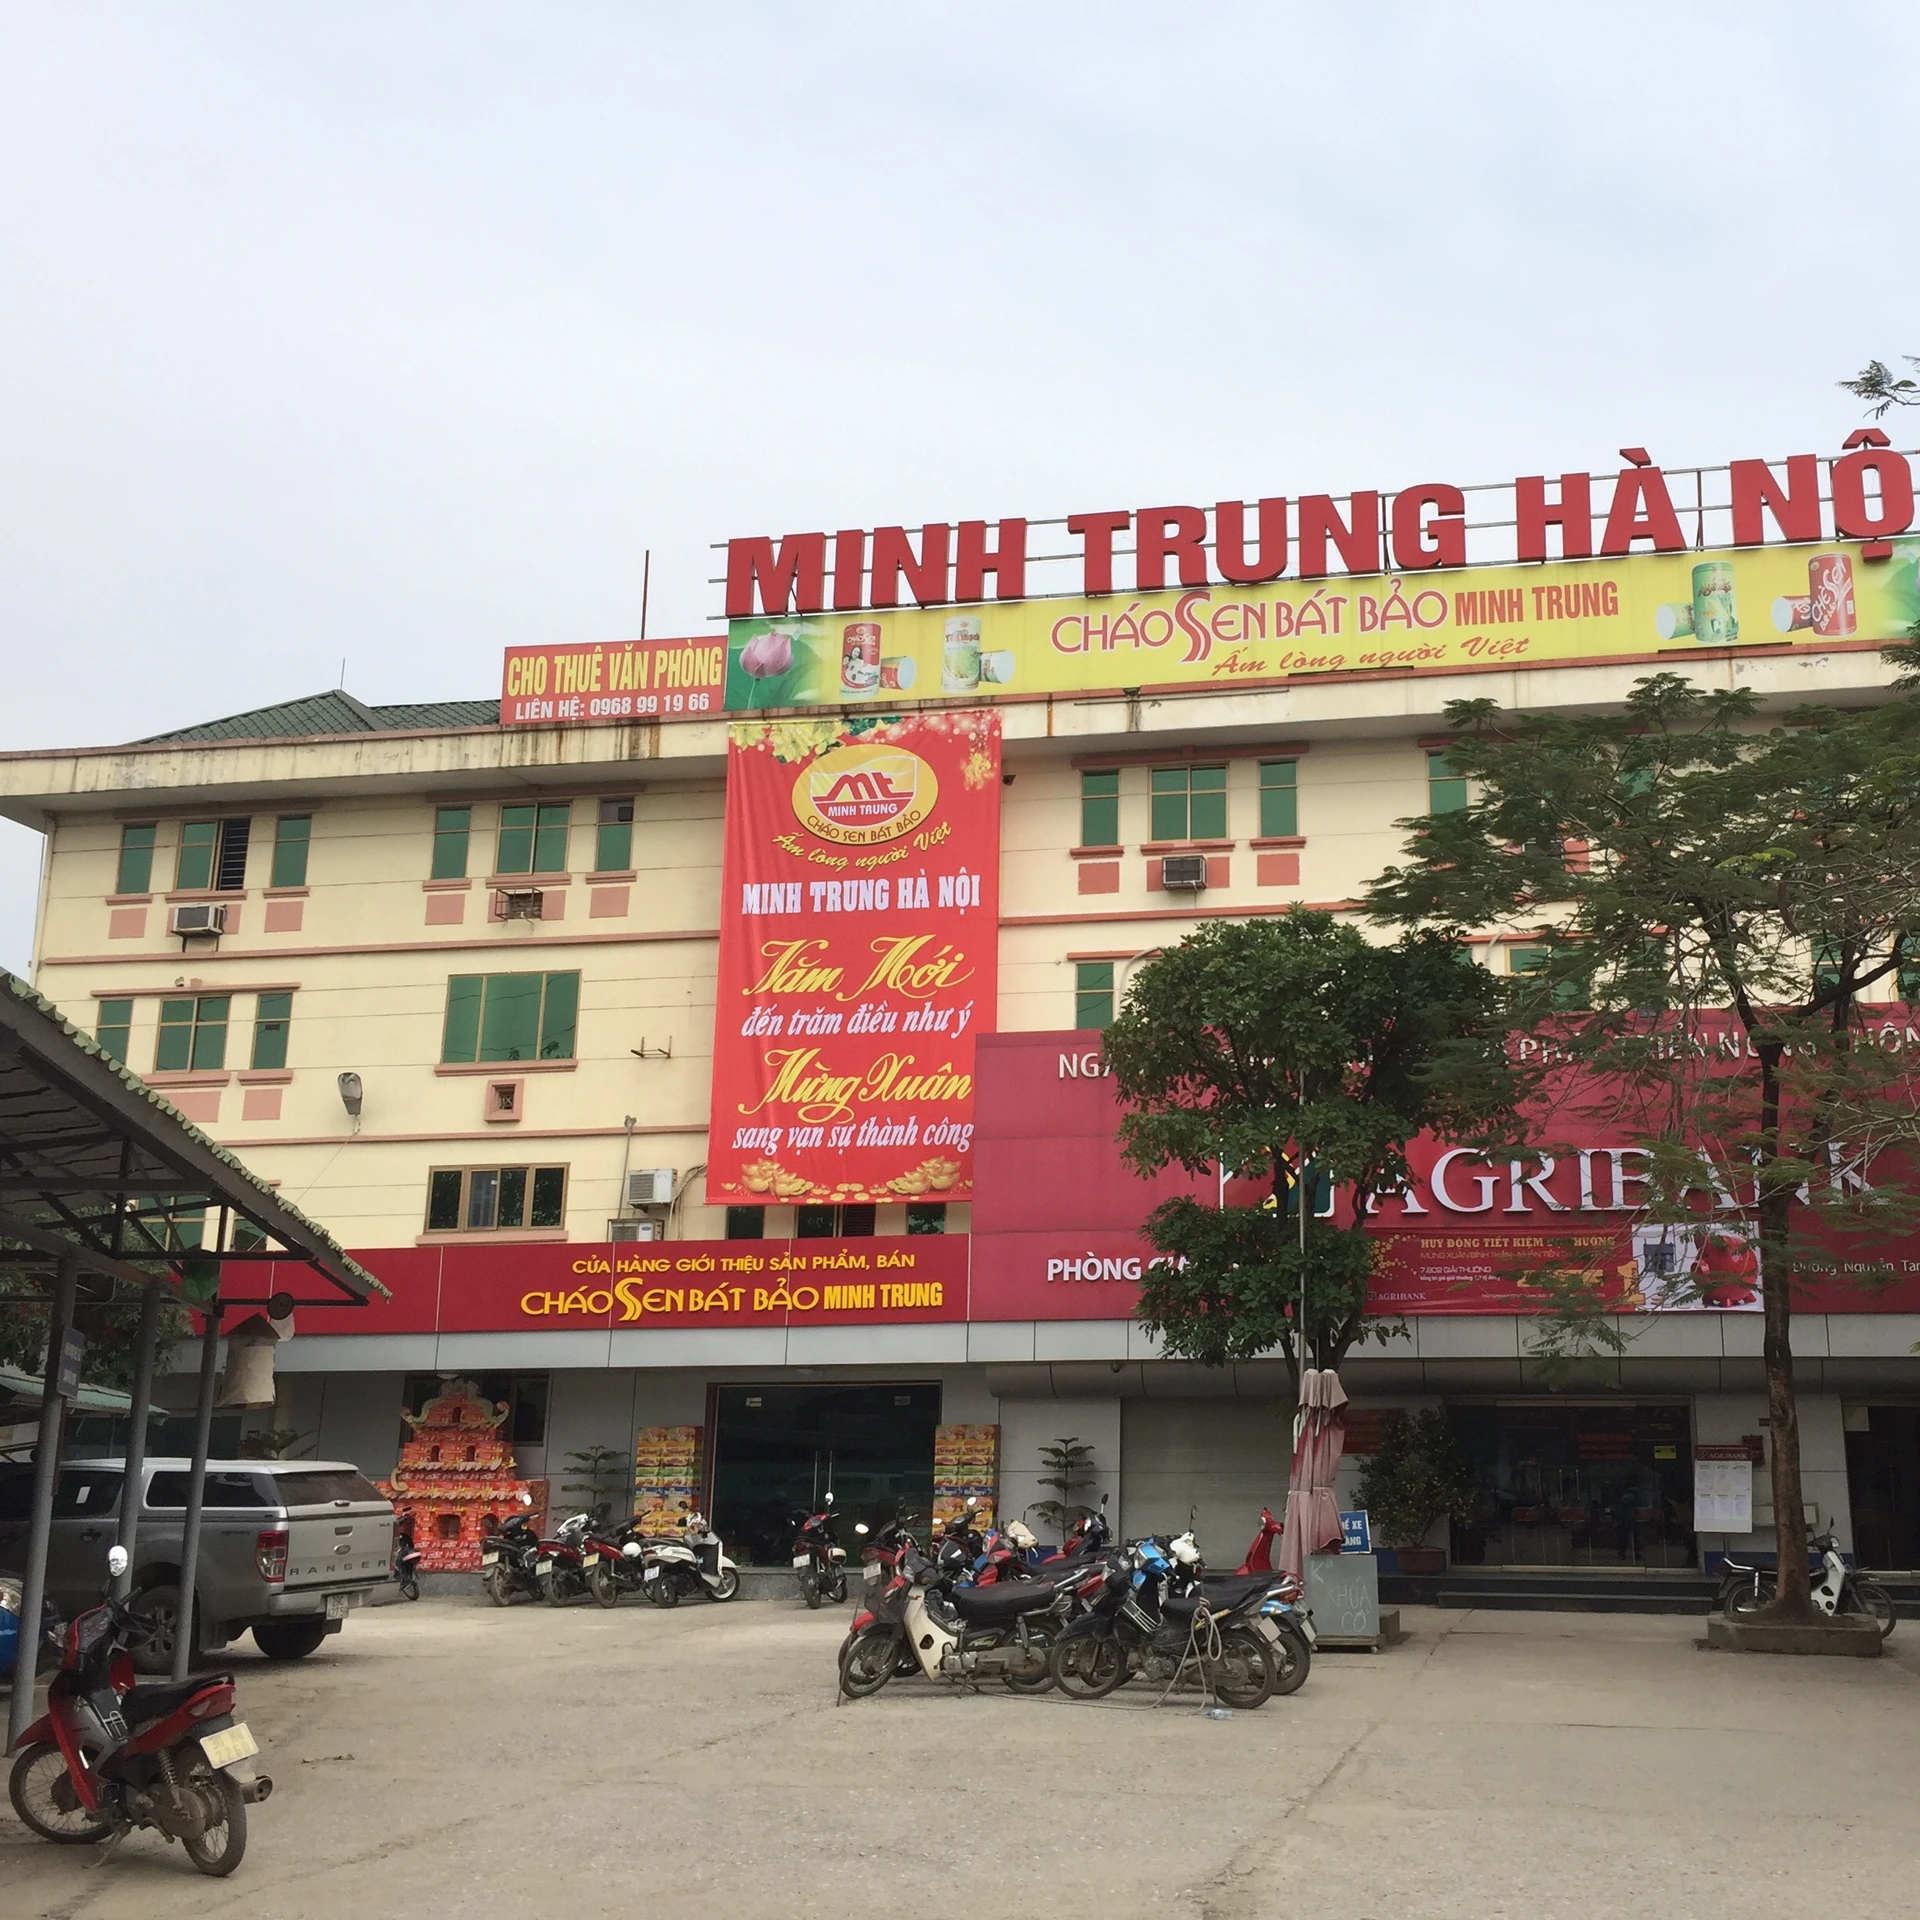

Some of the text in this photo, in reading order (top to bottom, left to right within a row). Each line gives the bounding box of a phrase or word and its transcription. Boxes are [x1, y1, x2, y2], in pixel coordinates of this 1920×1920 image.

[726, 516, 1027, 617] MINH
[1067, 483, 1466, 597] TRUNG
[1515, 447, 1686, 562] HÀ
[1050, 603, 1173, 653] CHÁO
[1277, 589, 1348, 638] BÁT
[1359, 578, 1448, 633] BẢO
[1455, 588, 1524, 626] MINH
[1531, 581, 1619, 621] TRUNG
[507, 639, 723, 697] CHO THUÊ VĂN PHÒNG
[1211, 636, 1530, 676] Ấm lòng người Việt
[515, 692, 710, 721] LIÊN HỆ: 0968 99 19 66
[807, 810, 921, 843] CHÁO SEN BÁT BẢO
[828, 803, 898, 817] MINH TRUNG
[771, 821, 952, 872] Ấm lòng người Việt
[742, 866, 981, 915] MINH TRUNG HÀ NỘI
[742, 934, 976, 1002] Năm Mới
[741, 1000, 974, 1039] đến trăm điều như ý
[738, 1048, 973, 1124] Mừng Xuân
[732, 1116, 975, 1156] sang vạn sự thành công
[572, 1248, 915, 1275] CỬA HÀNG GIỚI THIỆU SẢN PHẨM, BÁN
[1421, 1238, 1444, 1249] HUY
[1447, 1236, 1480, 1250] ĐỘNG
[1483, 1235, 1510, 1248] TIẾT
[1513, 1235, 1544, 1249] KIỆM
[1047, 1252, 1141, 1282] PHÒNG
[520, 1285, 614, 1315] CHÁO
[690, 1281, 746, 1313] BÁT
[753, 1277, 819, 1311] BẢO
[824, 1284, 876, 1310] MINH
[880, 1281, 943, 1307] TRUNG
[1378, 1292, 1426, 1300] AGRIBANK
[1352, 1520, 1362, 1530] XE
[290, 1560, 387, 1576] RANGER
